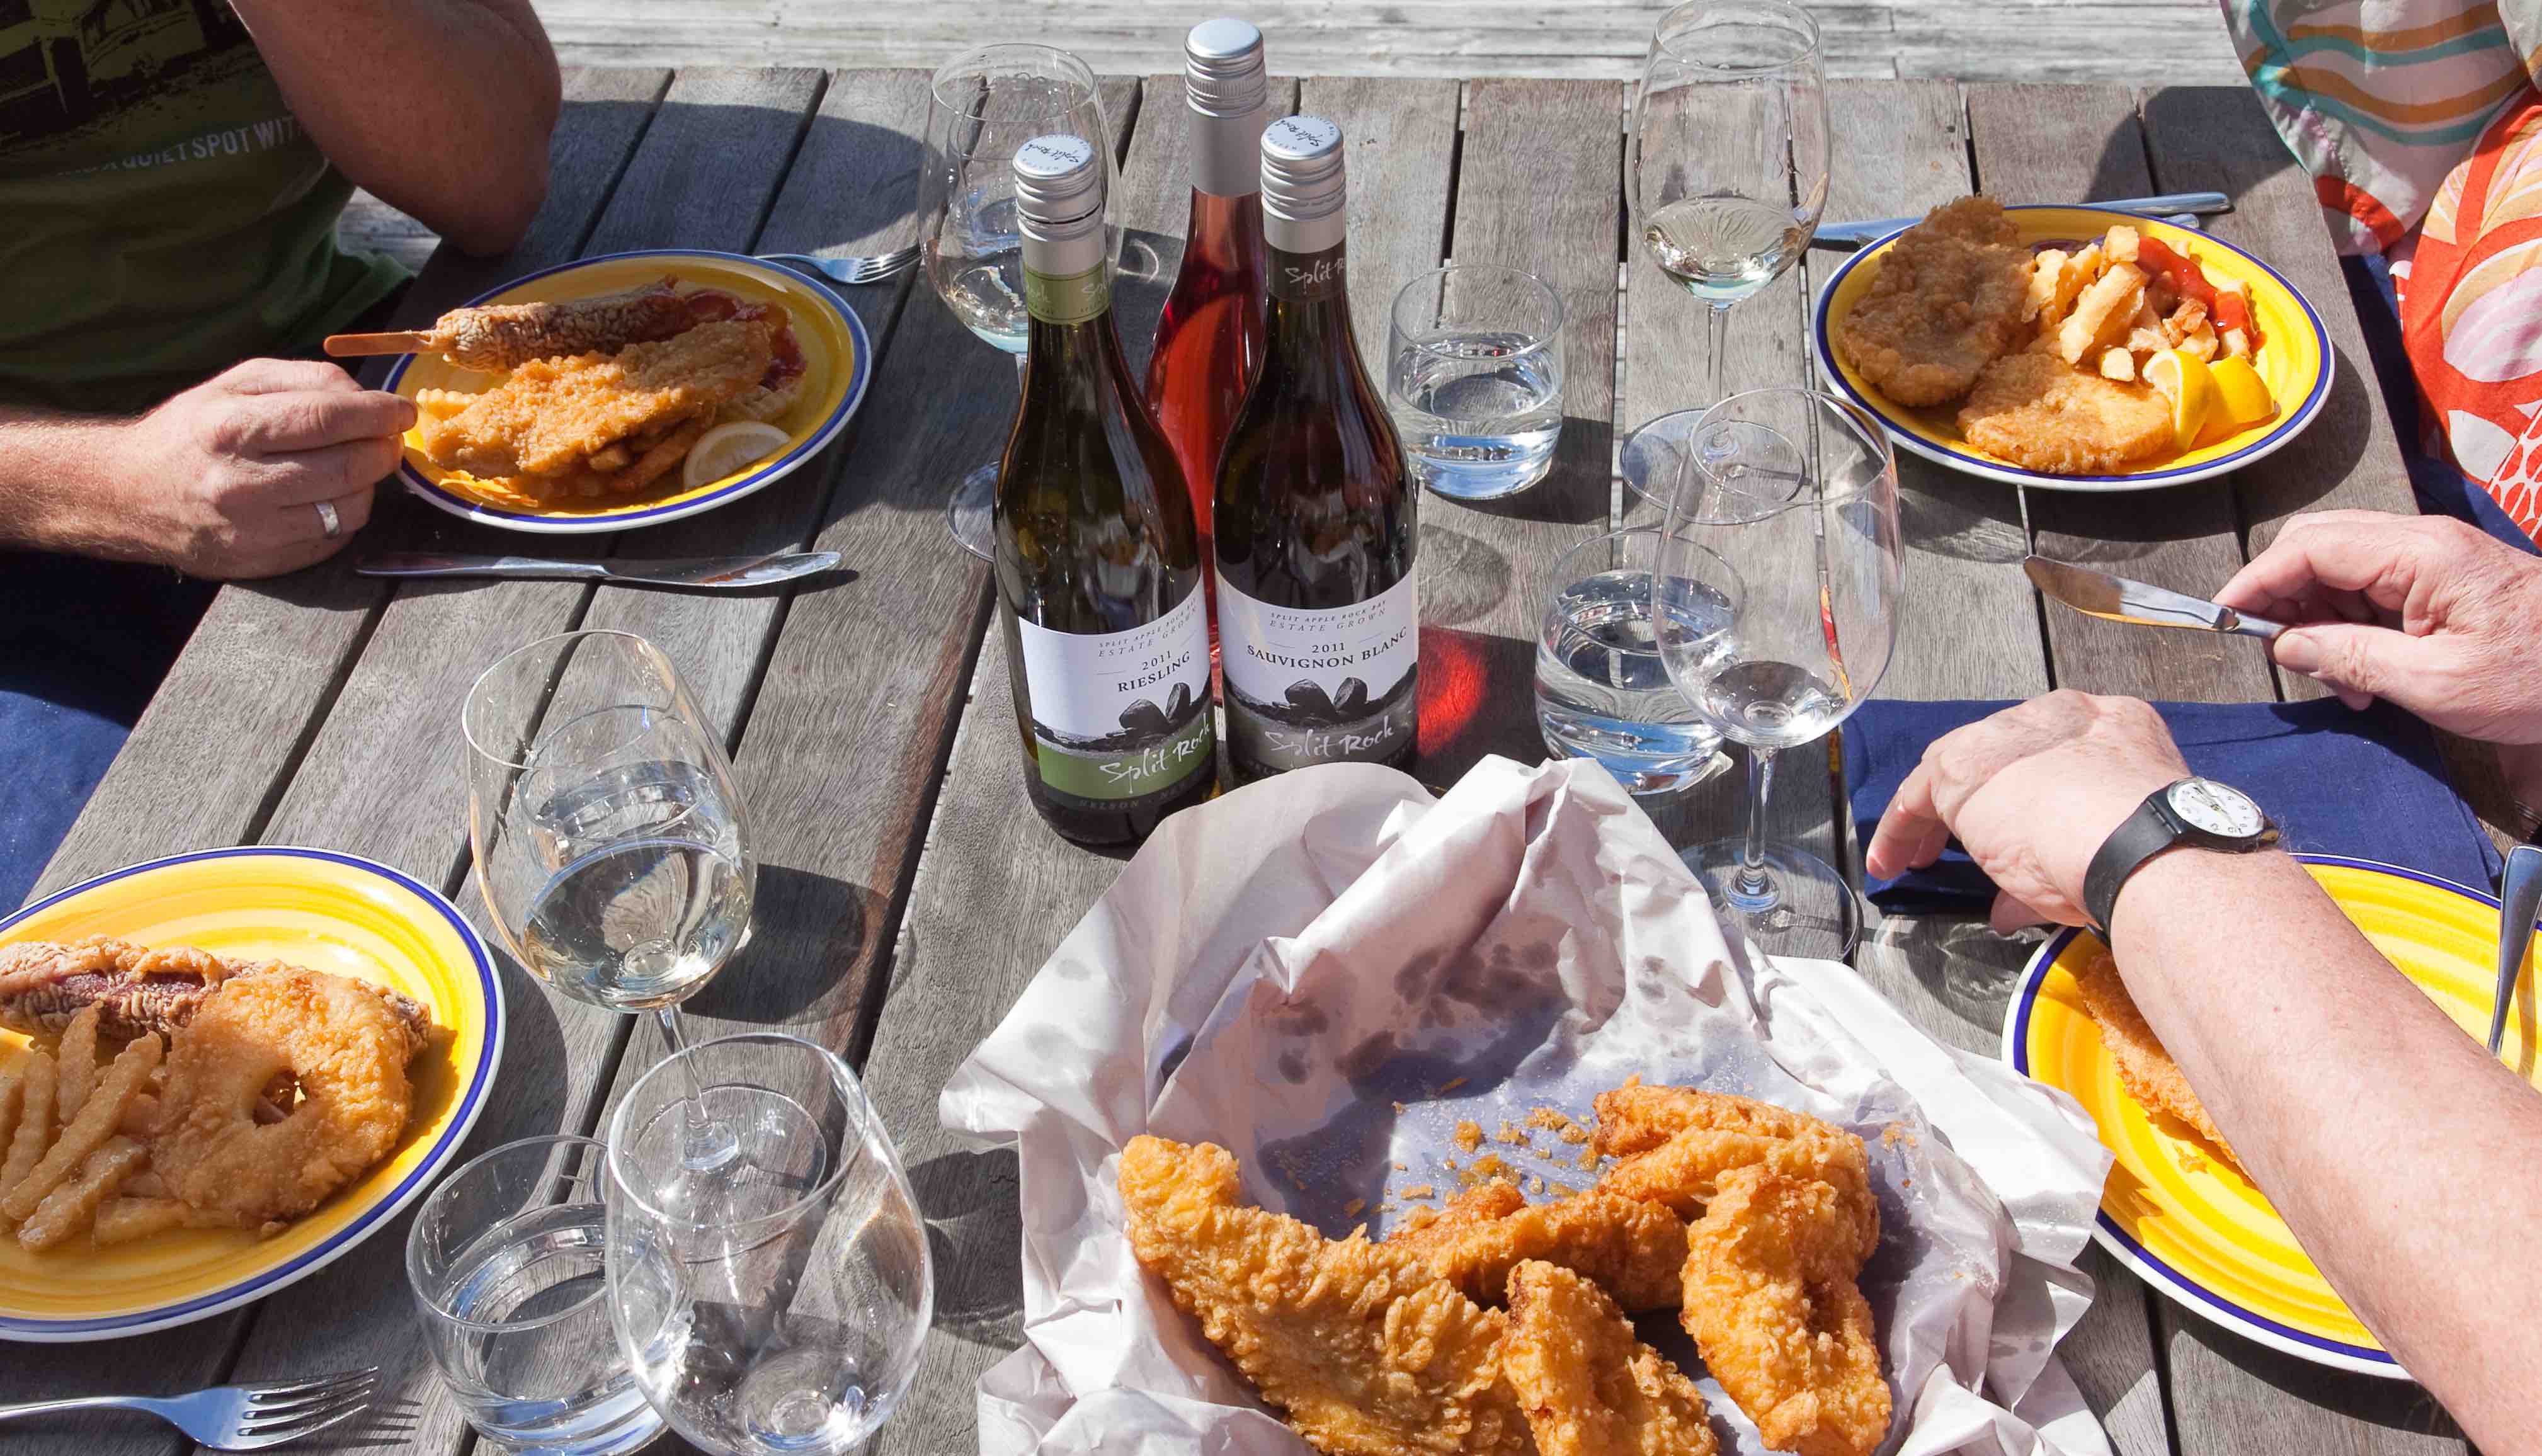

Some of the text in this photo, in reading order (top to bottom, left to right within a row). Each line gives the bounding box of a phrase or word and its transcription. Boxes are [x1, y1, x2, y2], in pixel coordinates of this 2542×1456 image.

[191, 127, 250, 158] SPOT
[253, 115, 302, 151] WIT
[1285, 259, 1332, 295] Split
[1269, 608, 1386, 632] ESTATE GROWN
[1271, 612, 1299, 622] SPLIT
[1304, 615, 1335, 623] APPLE
[1341, 608, 1367, 620] ROCK
[1098, 639, 1154, 657] ESTATE
[1099, 638, 1129, 647] SPLIT
[1246, 626, 1407, 669] SAUVIGNON BLANC
[1311, 642, 1346, 654] 2011
[1118, 650, 1190, 693] RIESLING
[1141, 650, 1171, 671] 2011
[1099, 748, 1170, 794] Split
[1172, 712, 1211, 763] Rock
[1265, 729, 1332, 768] Split
[1339, 715, 1394, 755] Rock
